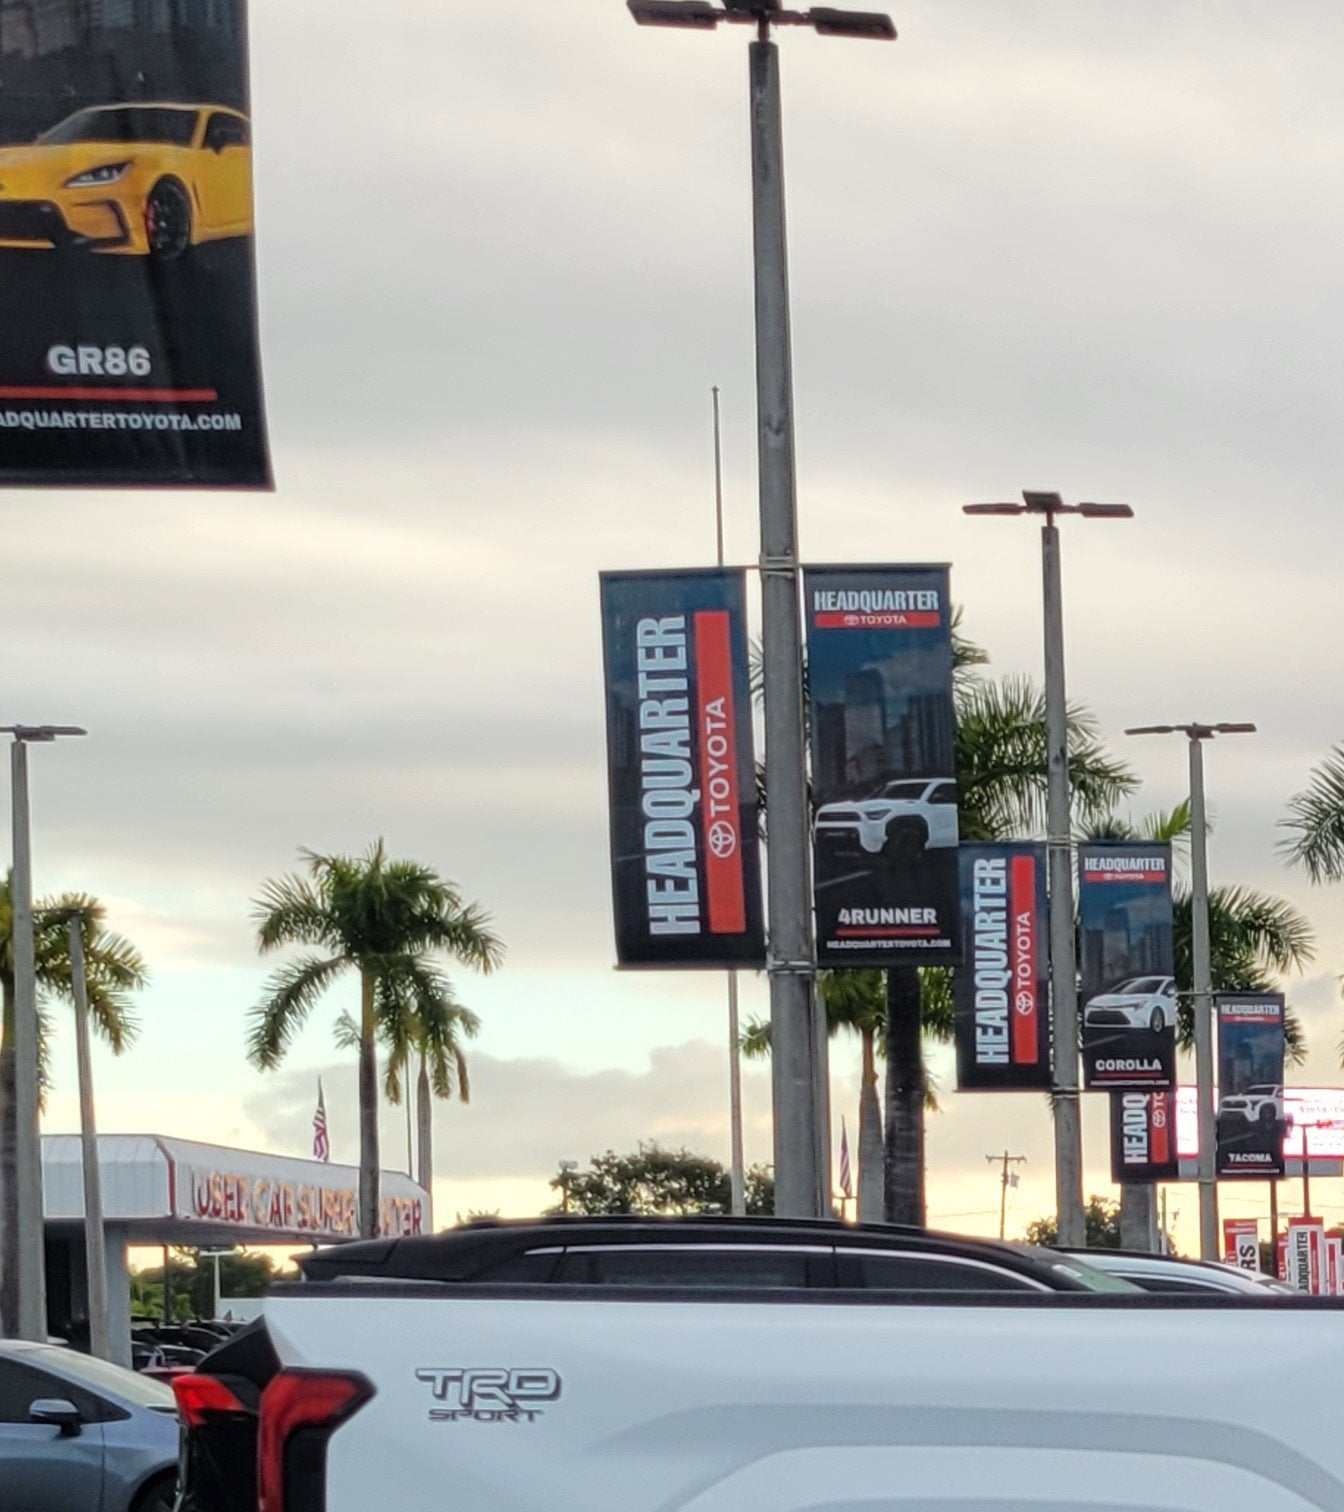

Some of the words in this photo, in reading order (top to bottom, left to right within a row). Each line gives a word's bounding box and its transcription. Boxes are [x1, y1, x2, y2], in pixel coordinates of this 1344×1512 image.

[48, 345, 151, 376] GR86
[814, 590, 939, 613] HEADQUARTER
[861, 614, 907, 625] TOYOTA
[705, 697, 730, 817] TOYOTA
[636, 614, 700, 935] HEADQUARTER
[1085, 857, 1165, 872] HEADQUARTER
[838, 907, 938, 925] 4RUNNER
[973, 857, 1012, 1064] HEADQUARTER
[1017, 911, 1033, 989] TOYOTA
[1095, 1058, 1162, 1071] COROLLA
[415, 1367, 562, 1409] TRD
[428, 1408, 545, 1423] SPORT
